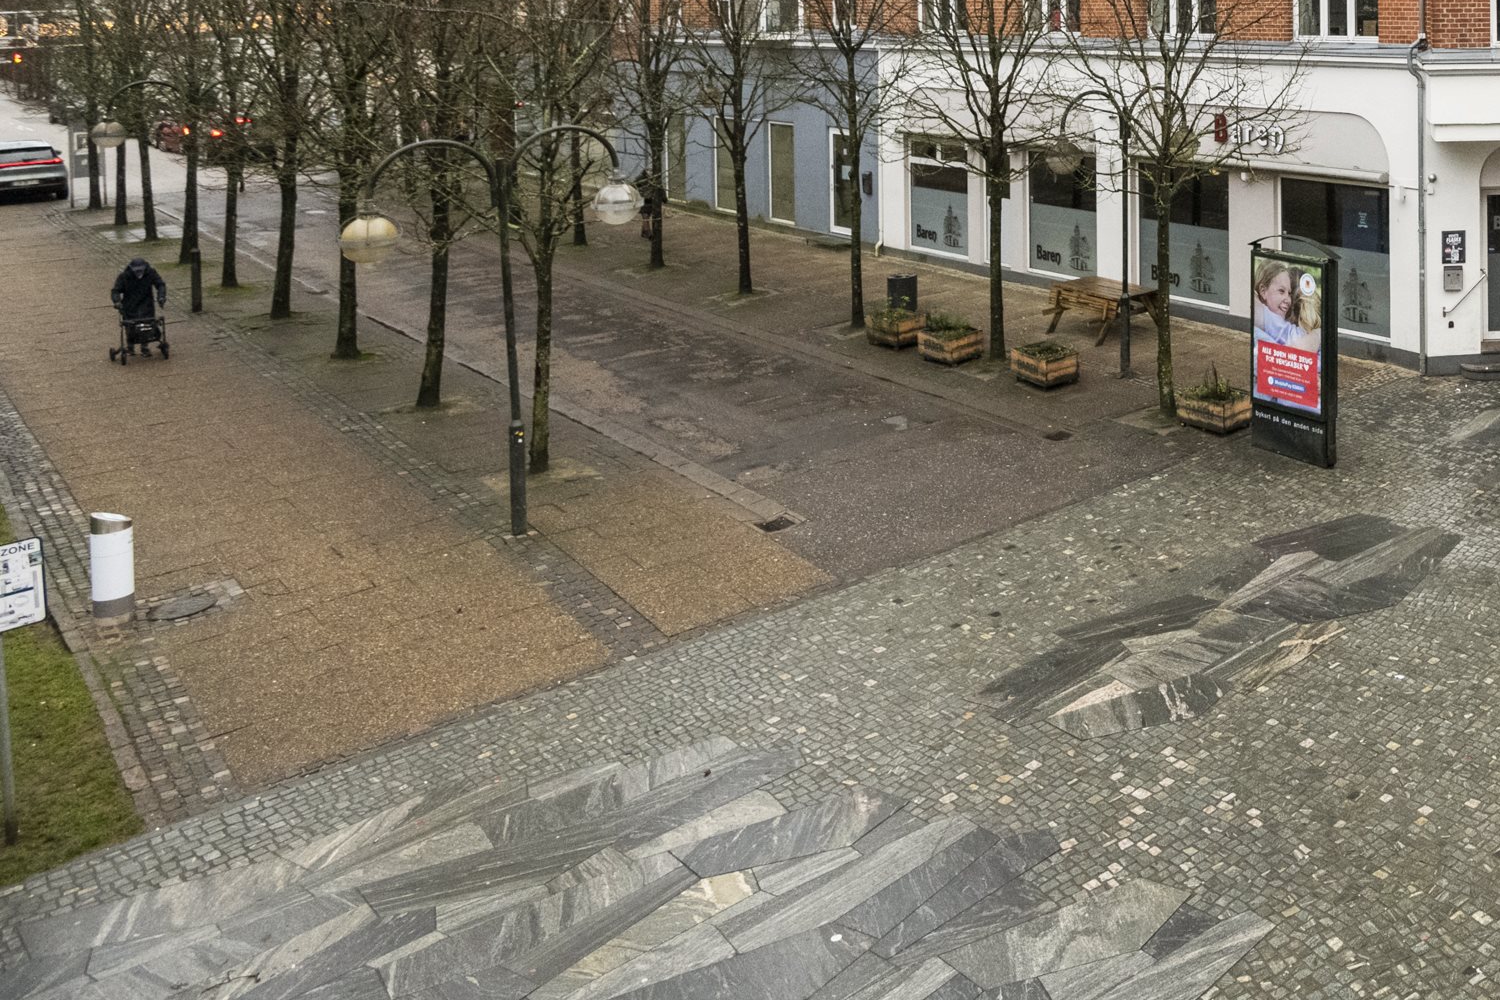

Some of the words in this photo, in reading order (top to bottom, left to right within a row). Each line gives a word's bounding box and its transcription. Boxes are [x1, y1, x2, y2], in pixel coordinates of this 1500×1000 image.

[1214, 113, 1285, 152] Baren
[917, 224, 937, 243] Baren
[1037, 244, 1061, 266] Baren
[1, 541, 35, 556] ZONE
